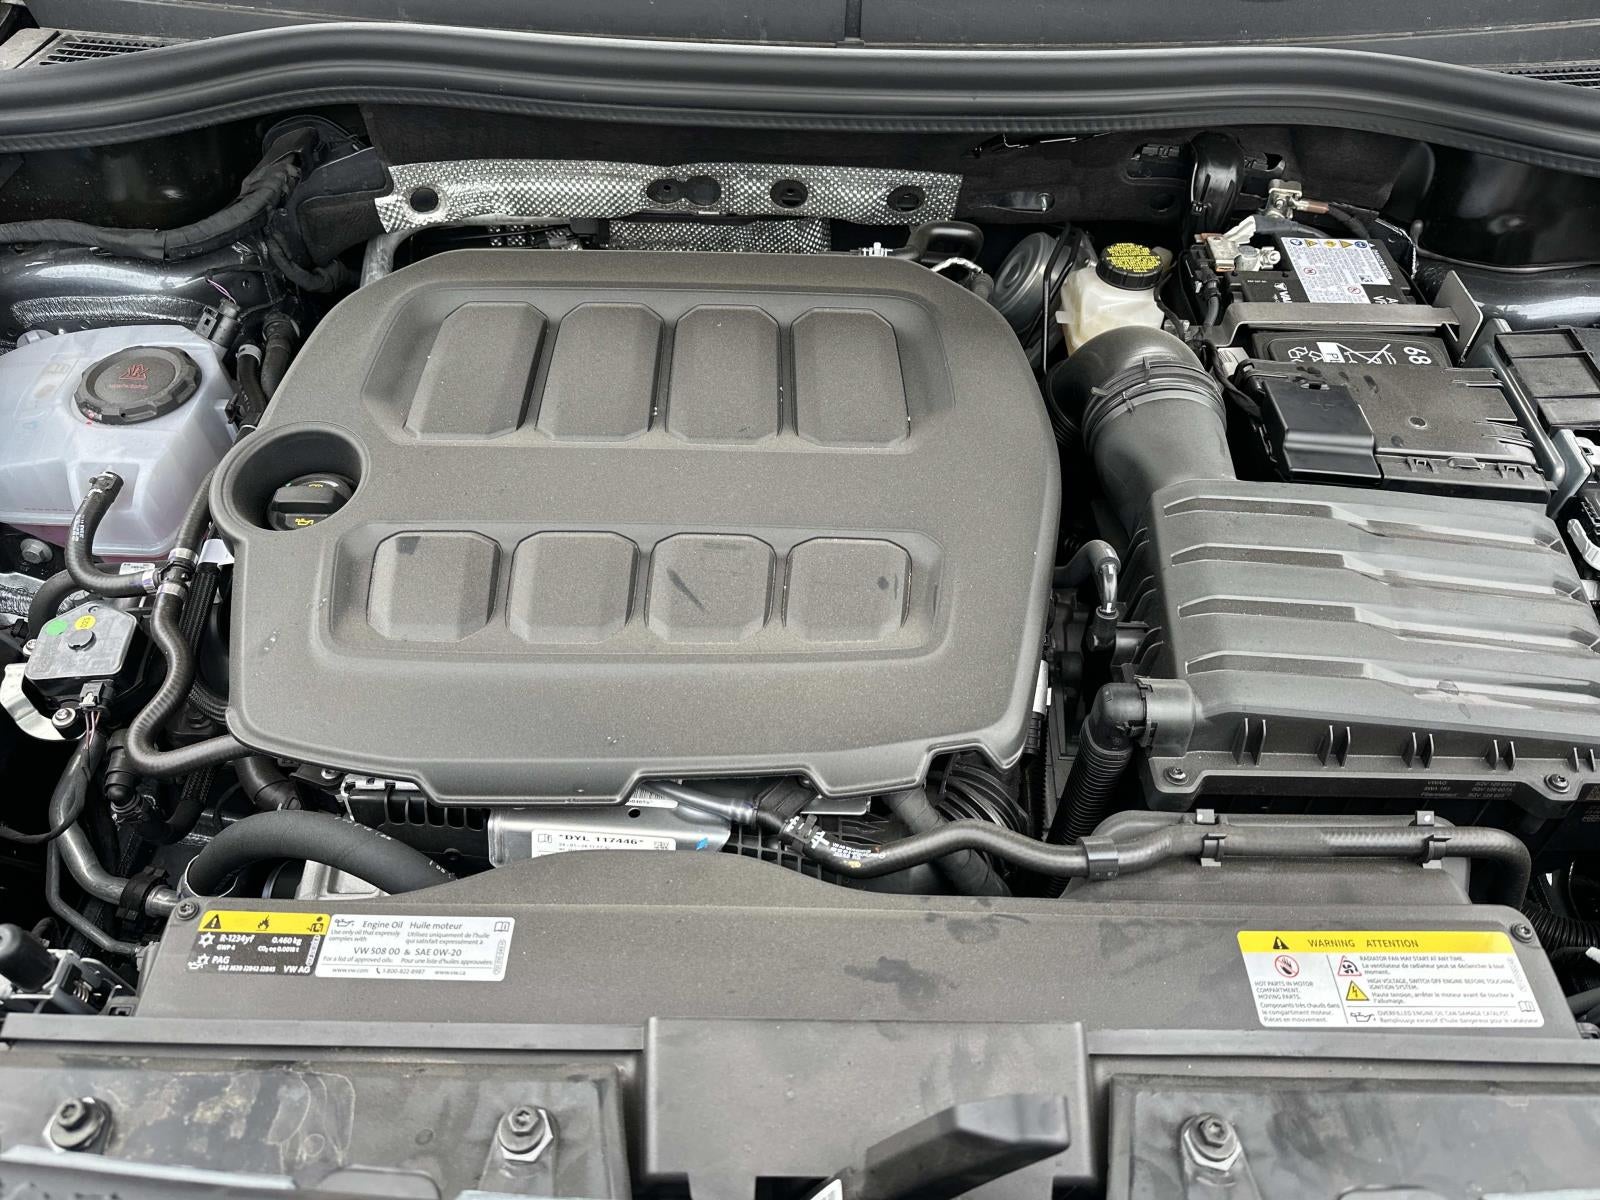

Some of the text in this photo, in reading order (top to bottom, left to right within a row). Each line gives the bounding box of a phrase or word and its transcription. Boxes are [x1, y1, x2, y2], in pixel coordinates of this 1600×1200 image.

[362, 920, 403, 930] Engine Oil
[409, 922, 462, 930] Huile moteur
[219, 934, 255, 944] R-1234yf
[271, 936, 303, 946] 0.460 kg
[1308, 939, 1419, 948] WARNING ATTENTION
[354, 947, 370, 955] VW
[370, 947, 387, 955] 508
[403, 948, 410, 956] &
[415, 948, 432, 956] SAE
[433, 948, 462, 956] 0W-20
[211, 956, 230, 964] PAG
[283, 965, 311, 974] VW AG
